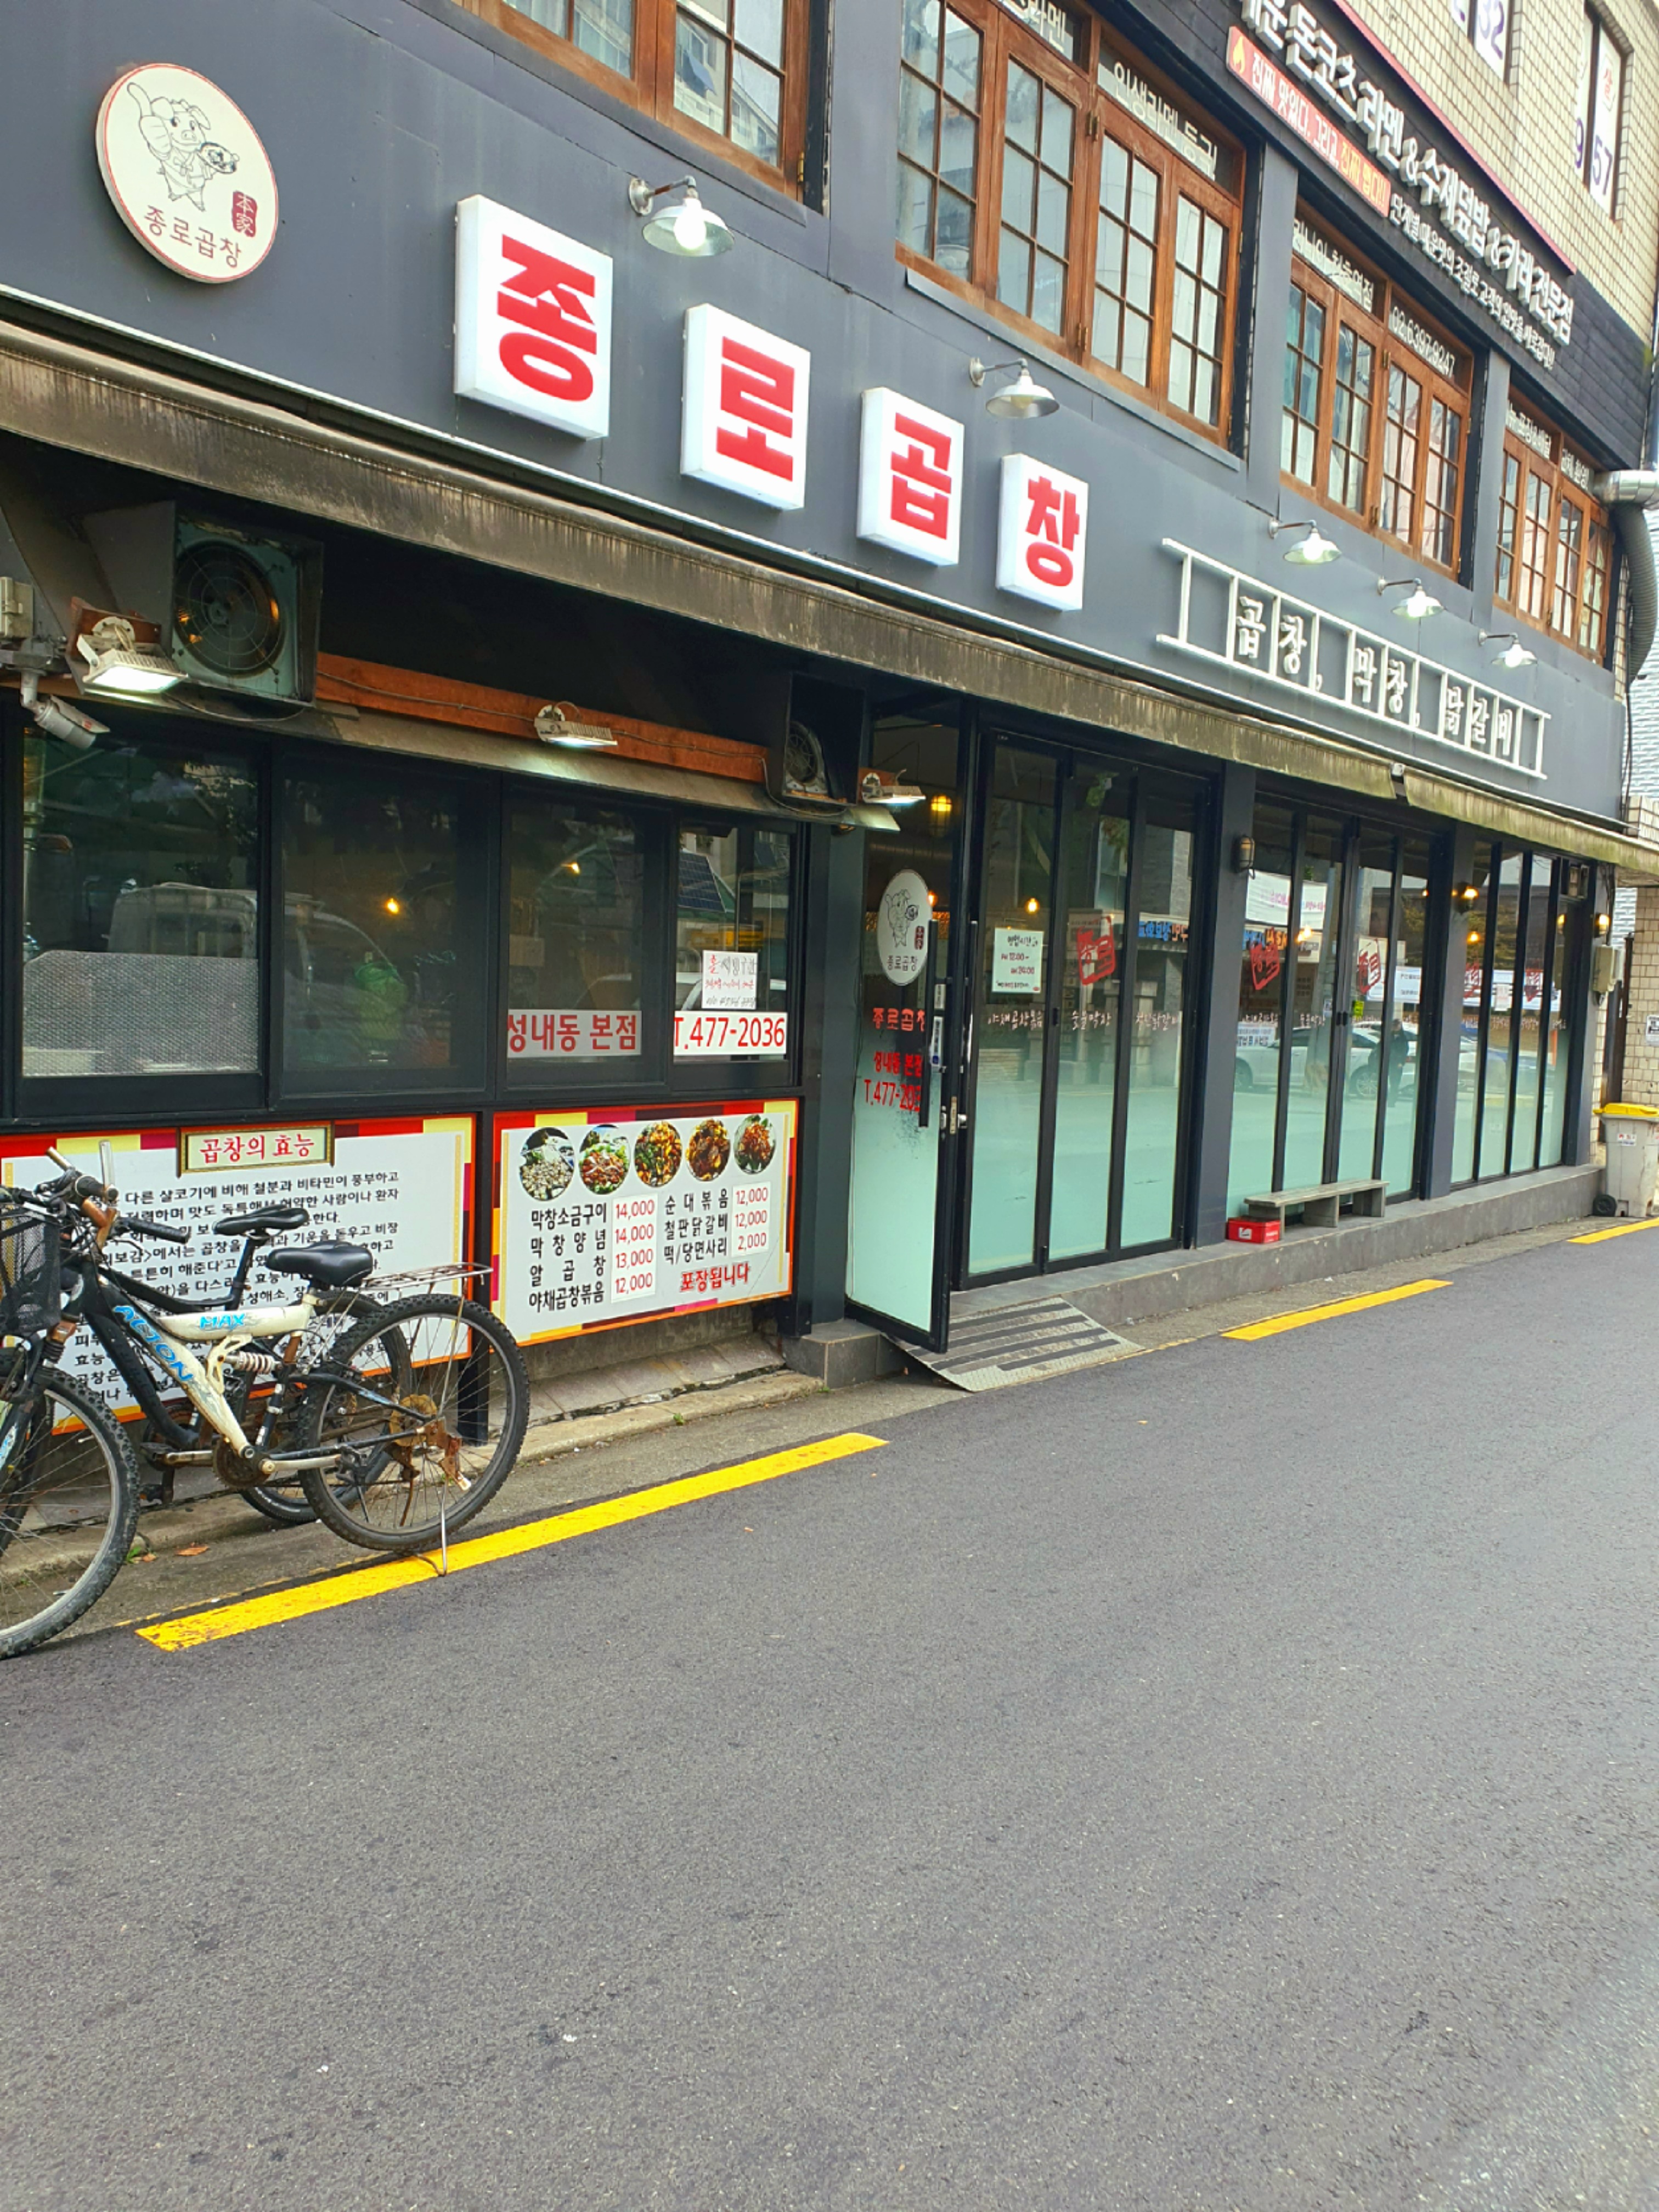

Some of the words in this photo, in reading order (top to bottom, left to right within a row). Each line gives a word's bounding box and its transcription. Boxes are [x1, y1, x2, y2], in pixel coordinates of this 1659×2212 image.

[1253, 52, 1276, 105] 진짜
[143, 204, 242, 270] 종로곱창
[496, 234, 1081, 587] 종로곱창
[1446, 686, 1513, 756] 닭갈비
[508, 1014, 580, 1053] 성내동
[590, 1014, 637, 1051] 본점
[674, 1017, 785, 1050] T.477-2036
[873, 1050, 901, 1075] 성내동
[200, 1134, 266, 1164] 곱창의
[273, 1133, 314, 1157] 효능
[125, 1191, 154, 1205] 다른
[160, 1186, 217, 1203] 살코기에
[222, 1183, 249, 1198] 비해
[253, 1180, 292, 1195] 철분과
[297, 1175, 347, 1190] 비타민이
[351, 1171, 399, 1187] 풍부하고
[189, 1204, 216, 1218] 맛도
[323, 1189, 372, 1206] 사람이나
[375, 1187, 399, 1200] 환자
[736, 1187, 769, 1206] 12,000
[375, 1222, 398, 1234] 비장
[531, 1203, 607, 1228] 막창소금구이
[615, 1199, 655, 1220] 14,000
[664, 1212, 728, 1240] 철판닭갈비
[735, 1209, 768, 1228] 12,000
[201, 1239, 240, 1256] 곱창을
[614, 1223, 654, 1244] 14,000
[664, 1239, 728, 1265] 떡/당면사리
[737, 1231, 767, 1251] 2,000
[614, 1247, 654, 1269] 13,000
[528, 1283, 605, 1313] 야채곱창볶음
[614, 1272, 653, 1294] 12,000
[680, 1261, 751, 1293] 포장됩니다
[200, 1313, 245, 1330] MAX
